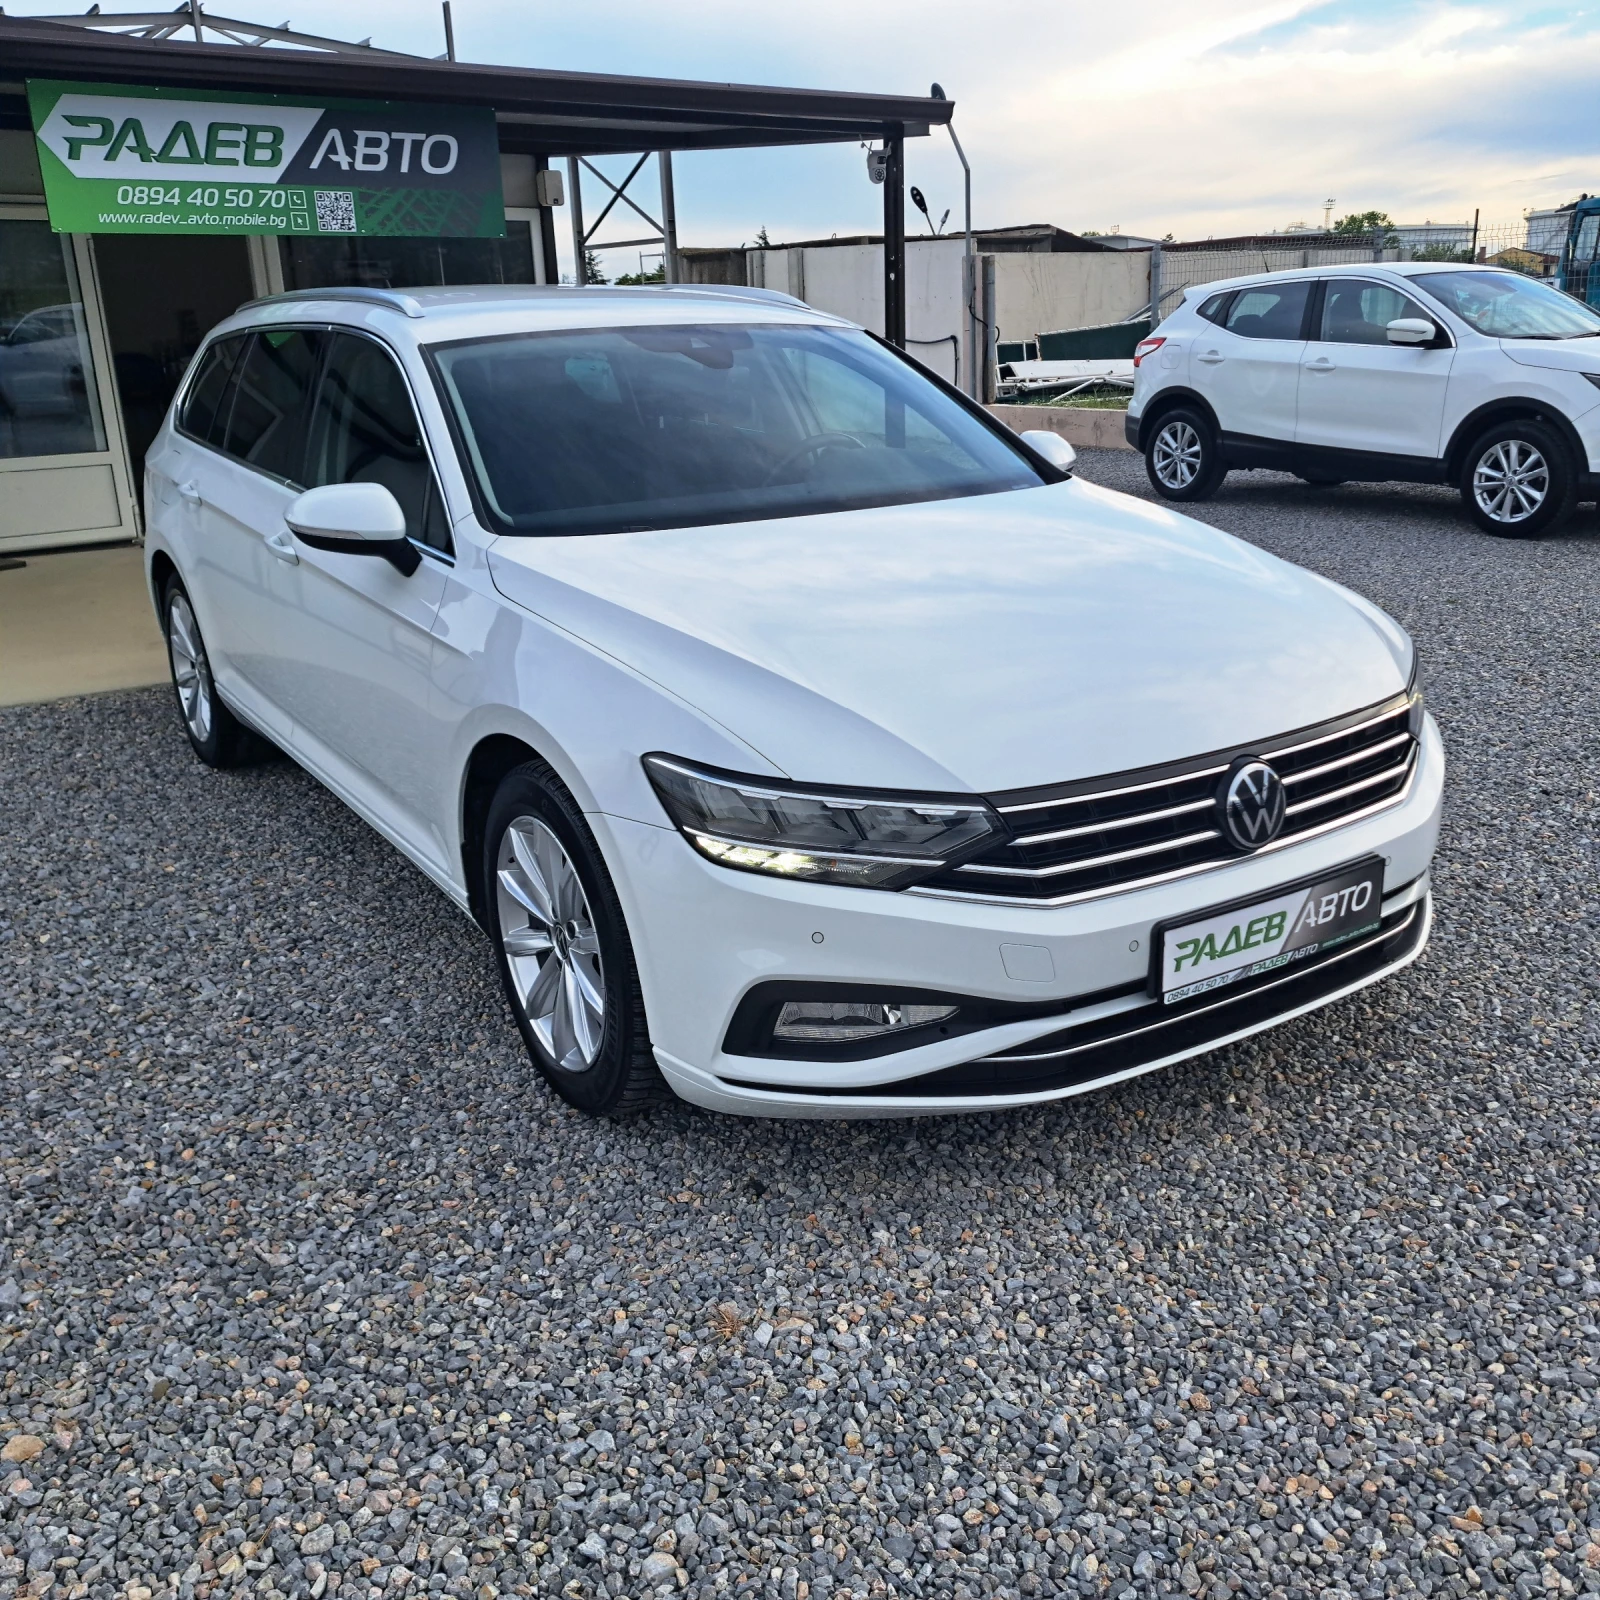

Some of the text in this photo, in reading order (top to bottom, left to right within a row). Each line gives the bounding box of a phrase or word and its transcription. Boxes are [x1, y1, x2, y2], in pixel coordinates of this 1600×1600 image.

[60, 114, 459, 175] РАДЕВ АВТО
[98, 211, 287, 229] www.radev_avto.mobile.bg
[117, 185, 286, 208] 0894 40 50 70
[1173, 910, 1287, 973] РАДЕВ
[1295, 880, 1373, 933] АВТО
[1167, 988, 1190, 1002] 0894
[1192, 983, 1203, 993] 40
[1205, 979, 1216, 990] 50
[1251, 954, 1289, 974] РАДЕВ
[1291, 943, 1319, 961] АВТО
